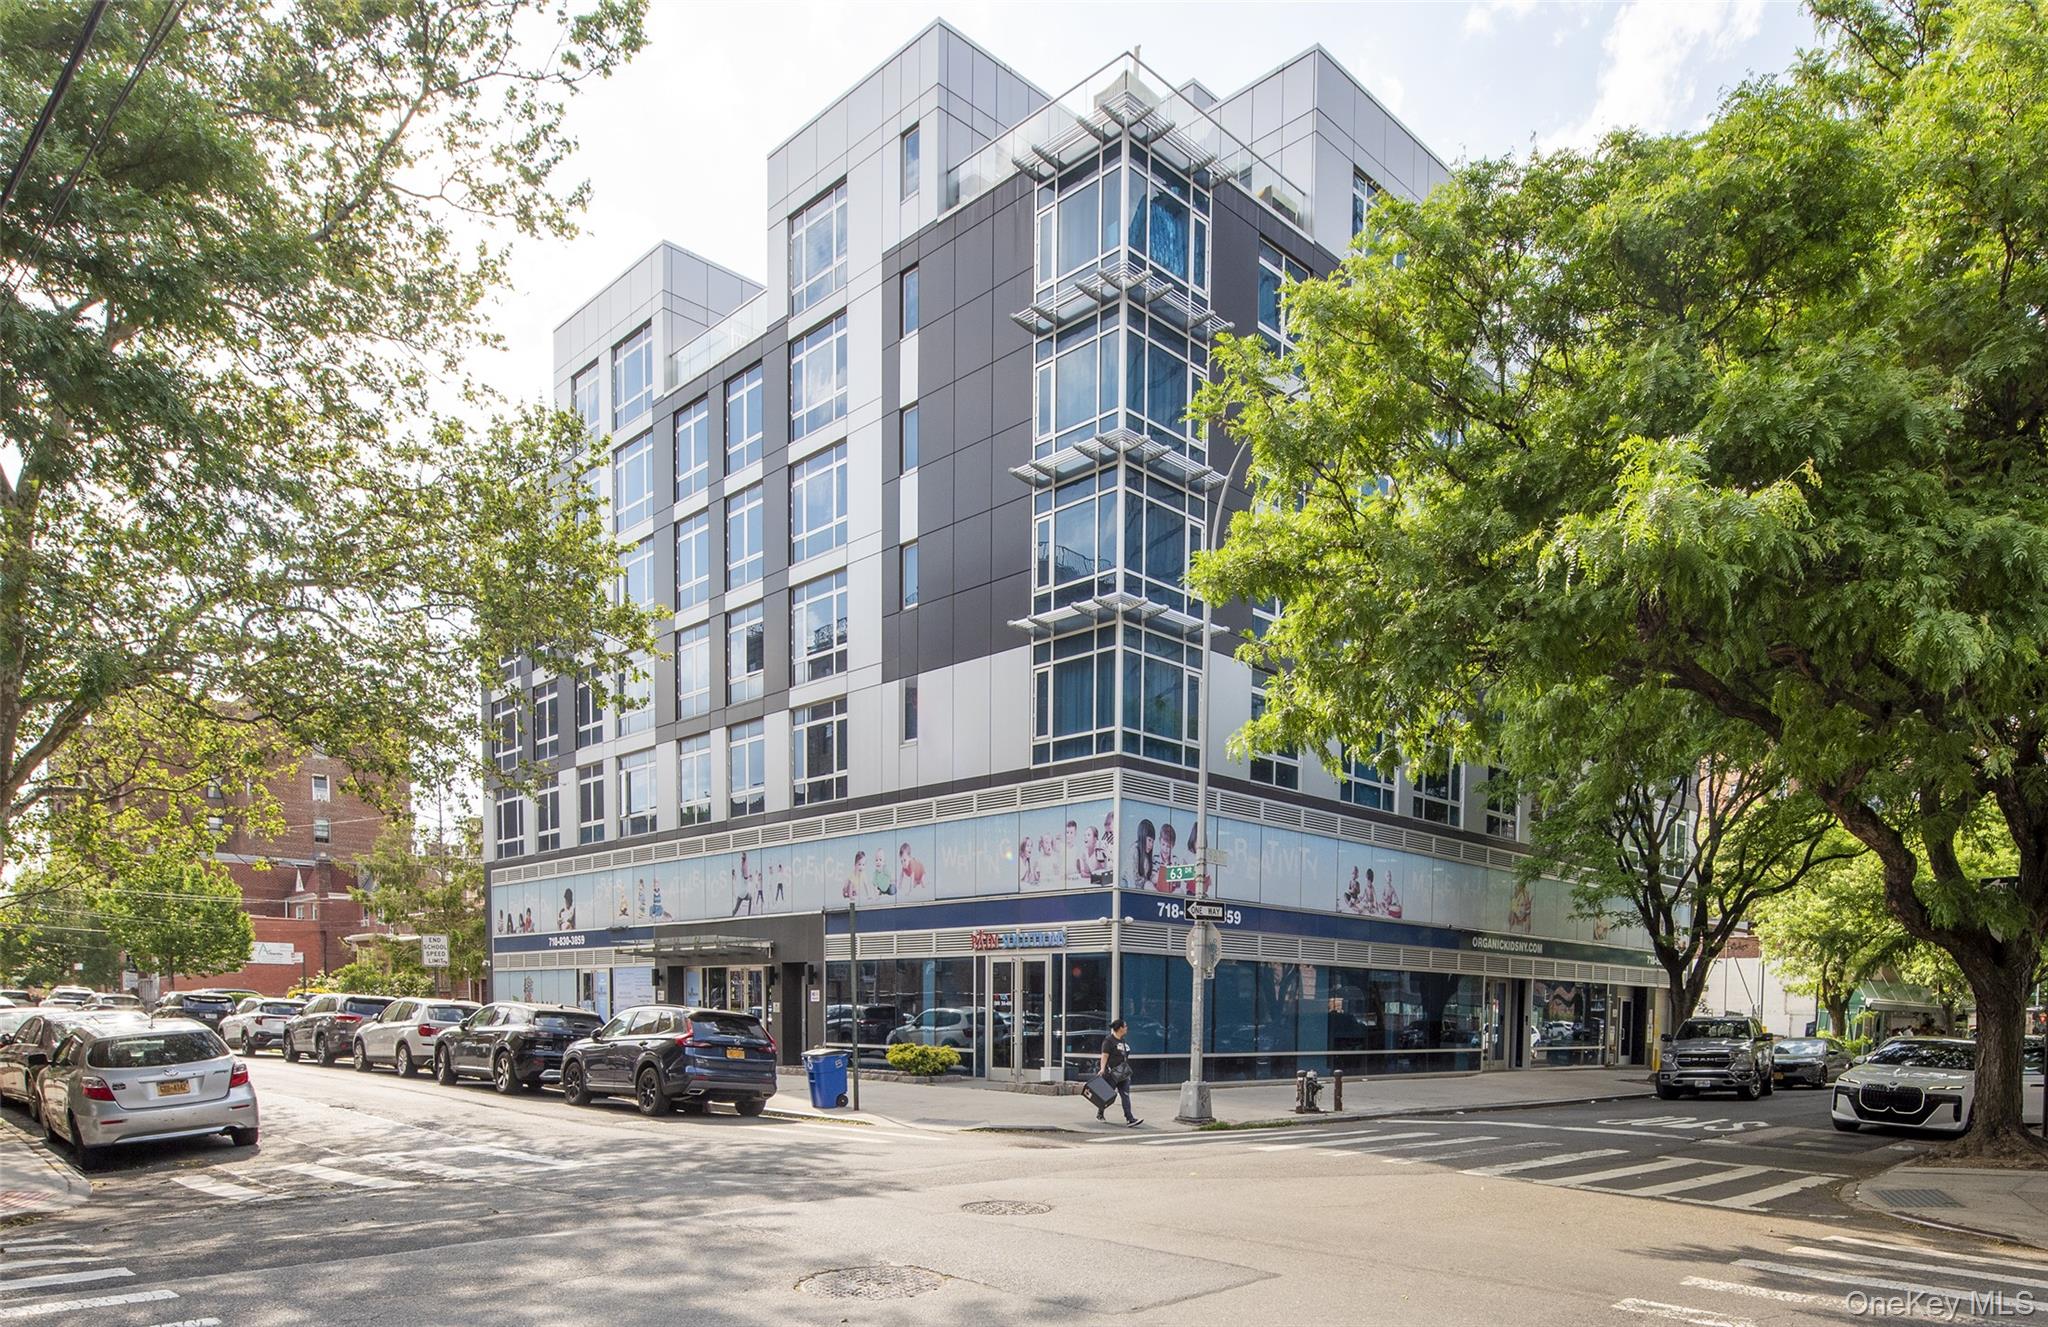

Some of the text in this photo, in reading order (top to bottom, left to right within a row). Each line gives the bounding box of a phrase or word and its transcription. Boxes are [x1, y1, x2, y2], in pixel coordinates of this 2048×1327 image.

[1170, 868, 1183, 879] 63
[1191, 905, 1220, 915] ONE WAY
[1472, 936, 1543, 954] ORGANICKIDSNY.COM
